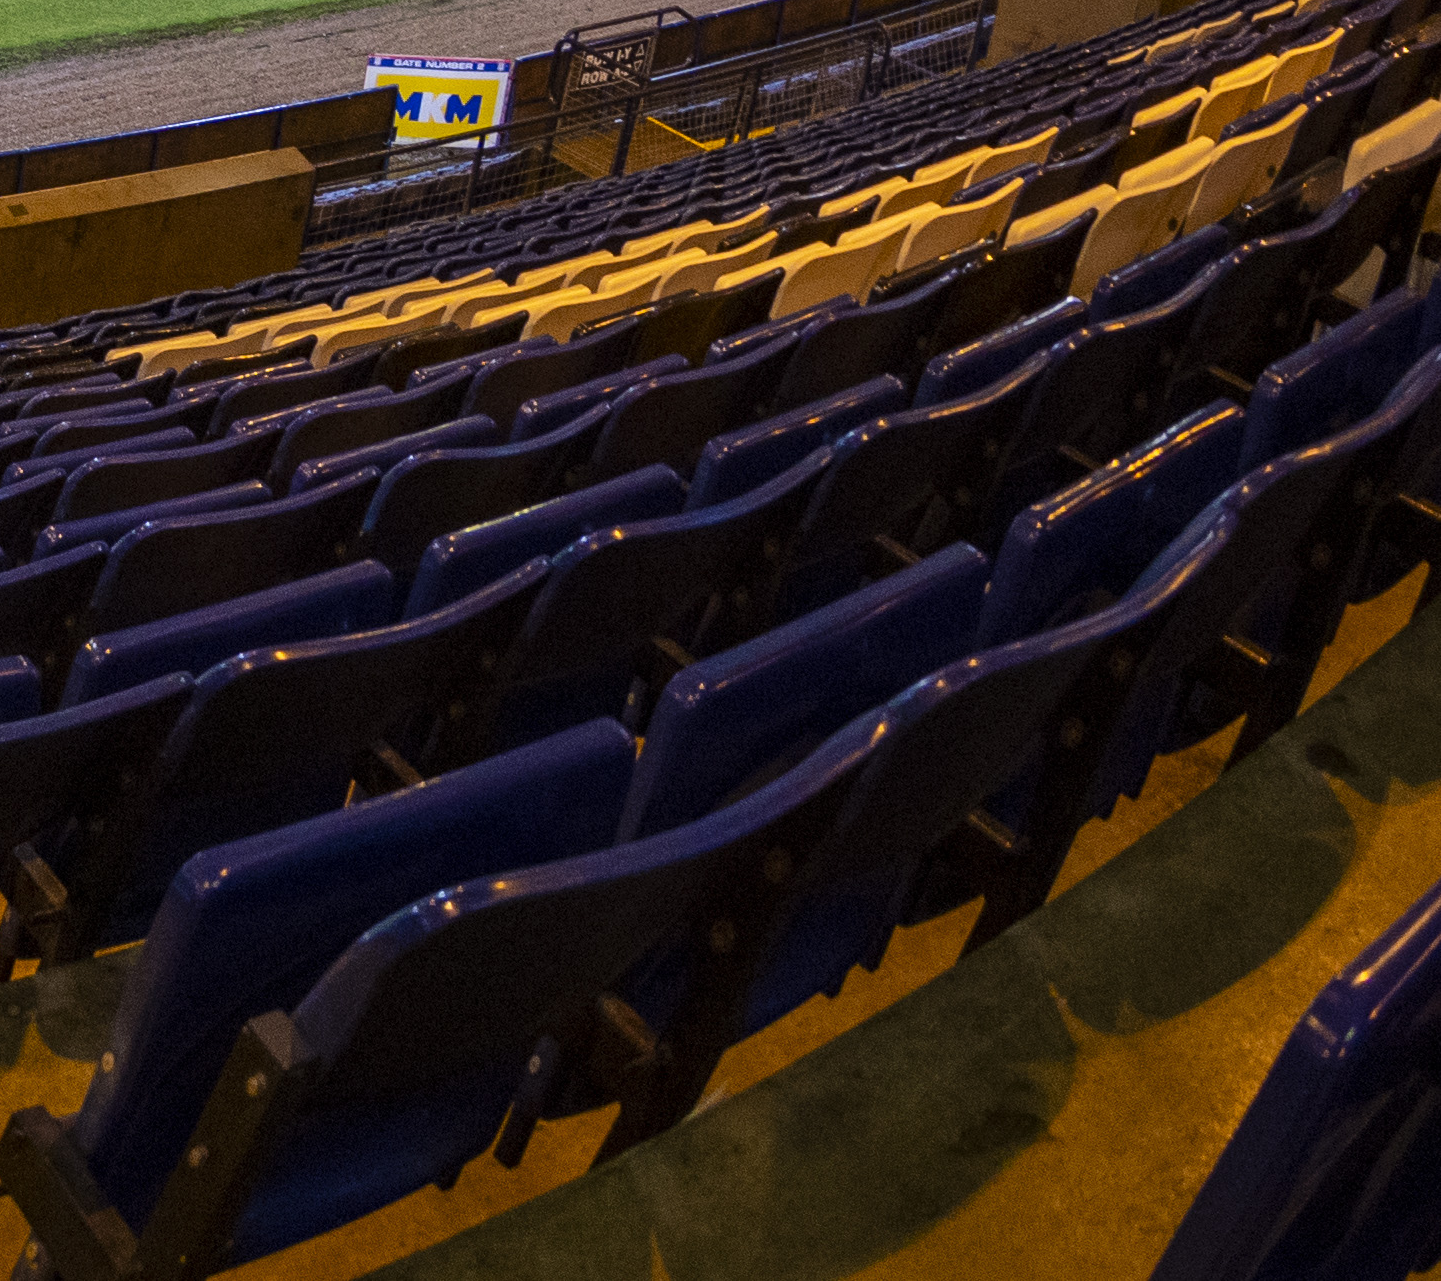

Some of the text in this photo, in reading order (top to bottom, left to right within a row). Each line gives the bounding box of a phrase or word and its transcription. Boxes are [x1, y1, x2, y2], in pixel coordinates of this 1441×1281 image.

[394, 59, 486, 71] GATE NUMBER 2
[394, 90, 483, 125] MKM
